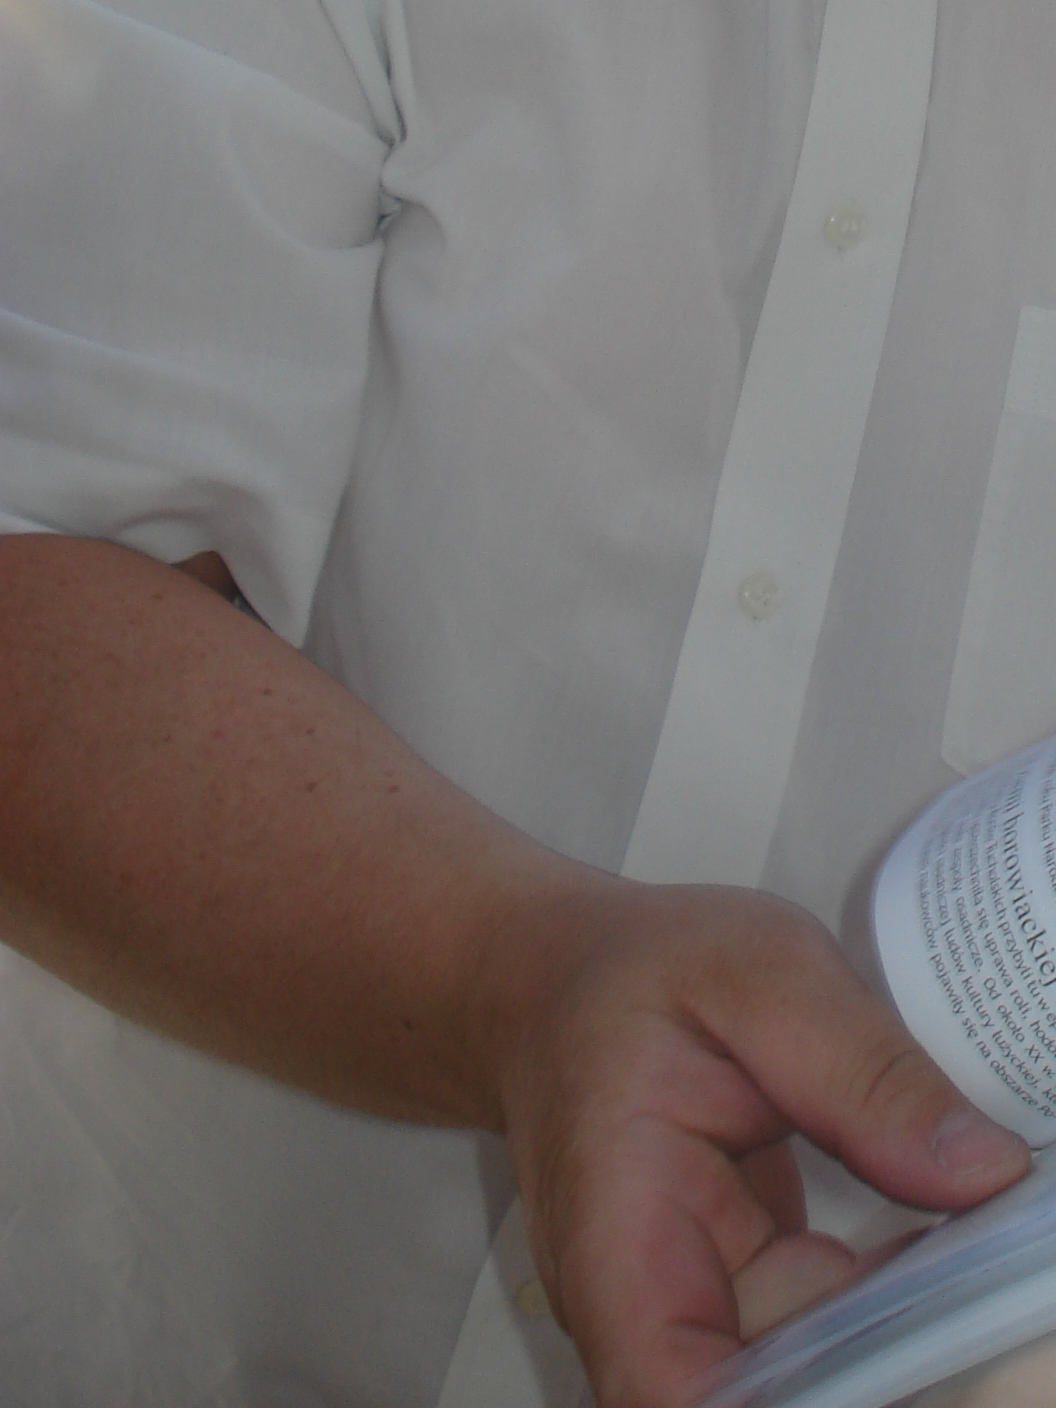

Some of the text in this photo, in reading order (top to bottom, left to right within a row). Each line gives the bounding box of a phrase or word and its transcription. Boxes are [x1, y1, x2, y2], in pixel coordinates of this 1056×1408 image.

[956, 895, 984, 973] osadnicze.
[983, 977, 1002, 1000] Od
[997, 1004, 1025, 1042] około
[1025, 1044, 1044, 1064] XX
[1043, 1064, 1056, 1079] w.
[977, 905, 990, 931] się
[983, 930, 1014, 988] uprawa
[986, 841, 1007, 921] Tucholskich
[998, 921, 1034, 980] przybyli
[1027, 979, 1041, 997] tu
[1037, 997, 1050, 1011] w
[930, 953, 965, 1015] pojawiły
[962, 1016, 978, 1039] się
[976, 1040, 992, 1059] na
[990, 1059, 1039, 1107] obszarze
[945, 927, 967, 973] ludów
[962, 975, 995, 1028] kultury
[992, 1029, 1038, 1089] łużyckiej,
[1010, 988, 1033, 1020] roli,
